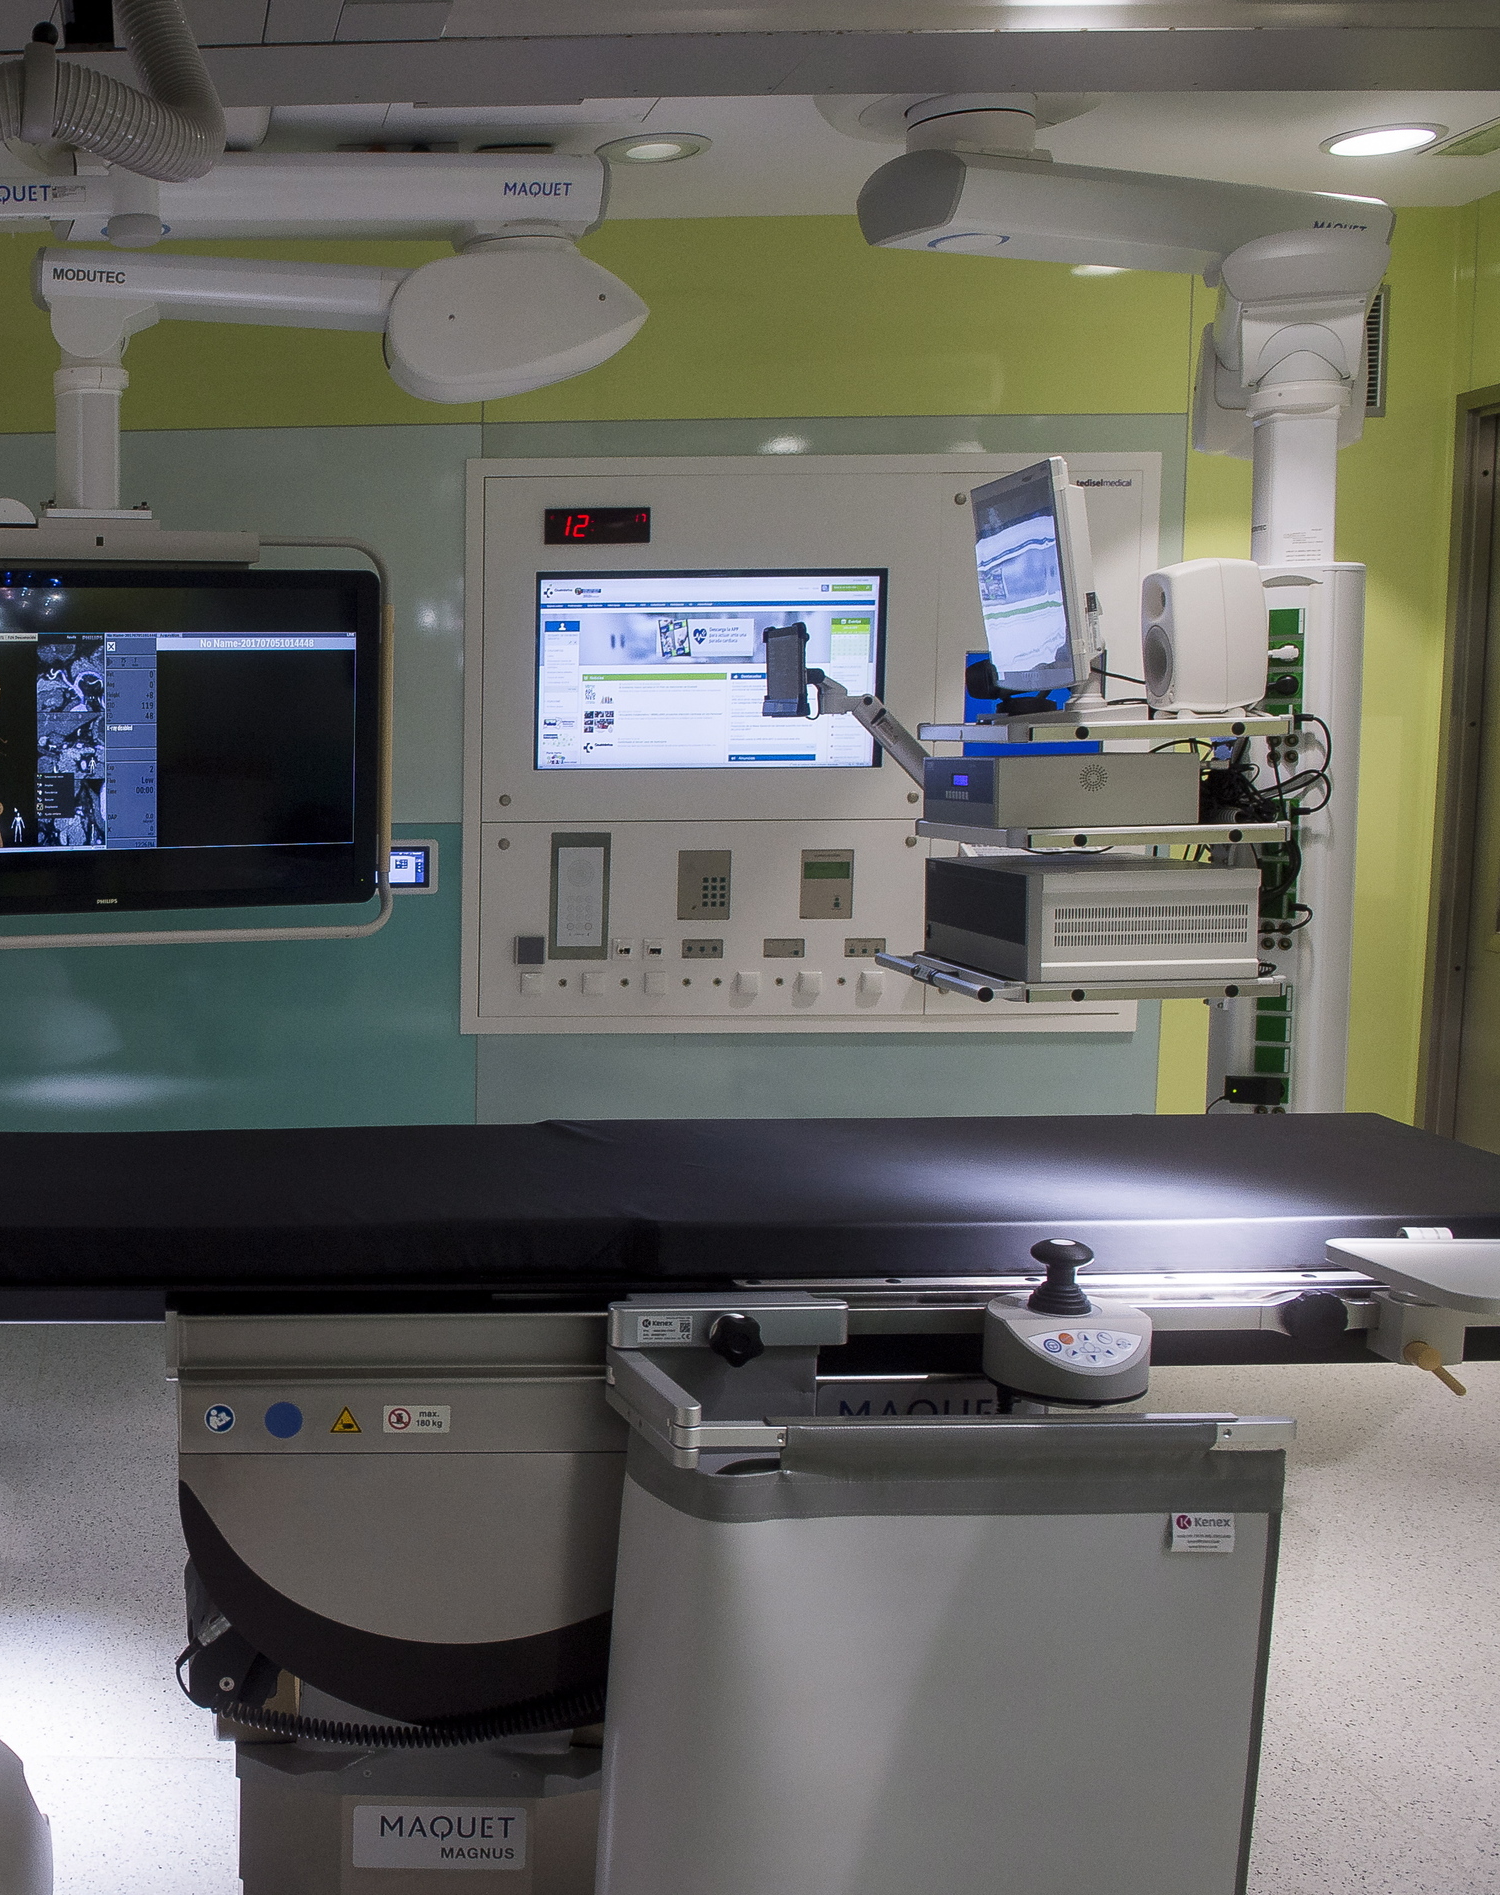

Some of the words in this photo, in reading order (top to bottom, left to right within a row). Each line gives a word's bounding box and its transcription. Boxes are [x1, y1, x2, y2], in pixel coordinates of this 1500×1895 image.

[503, 182, 572, 198] MAQUET
[52, 268, 126, 284] MODUTEC
[200, 639, 212, 648] No
[839, 1400, 1021, 1416] MAQUE
[432, 1419, 442, 1429] kg
[1194, 1517, 1231, 1527] Kenex
[380, 1816, 515, 1840] MAQUET
[440, 1847, 515, 1860] MAGNUS
